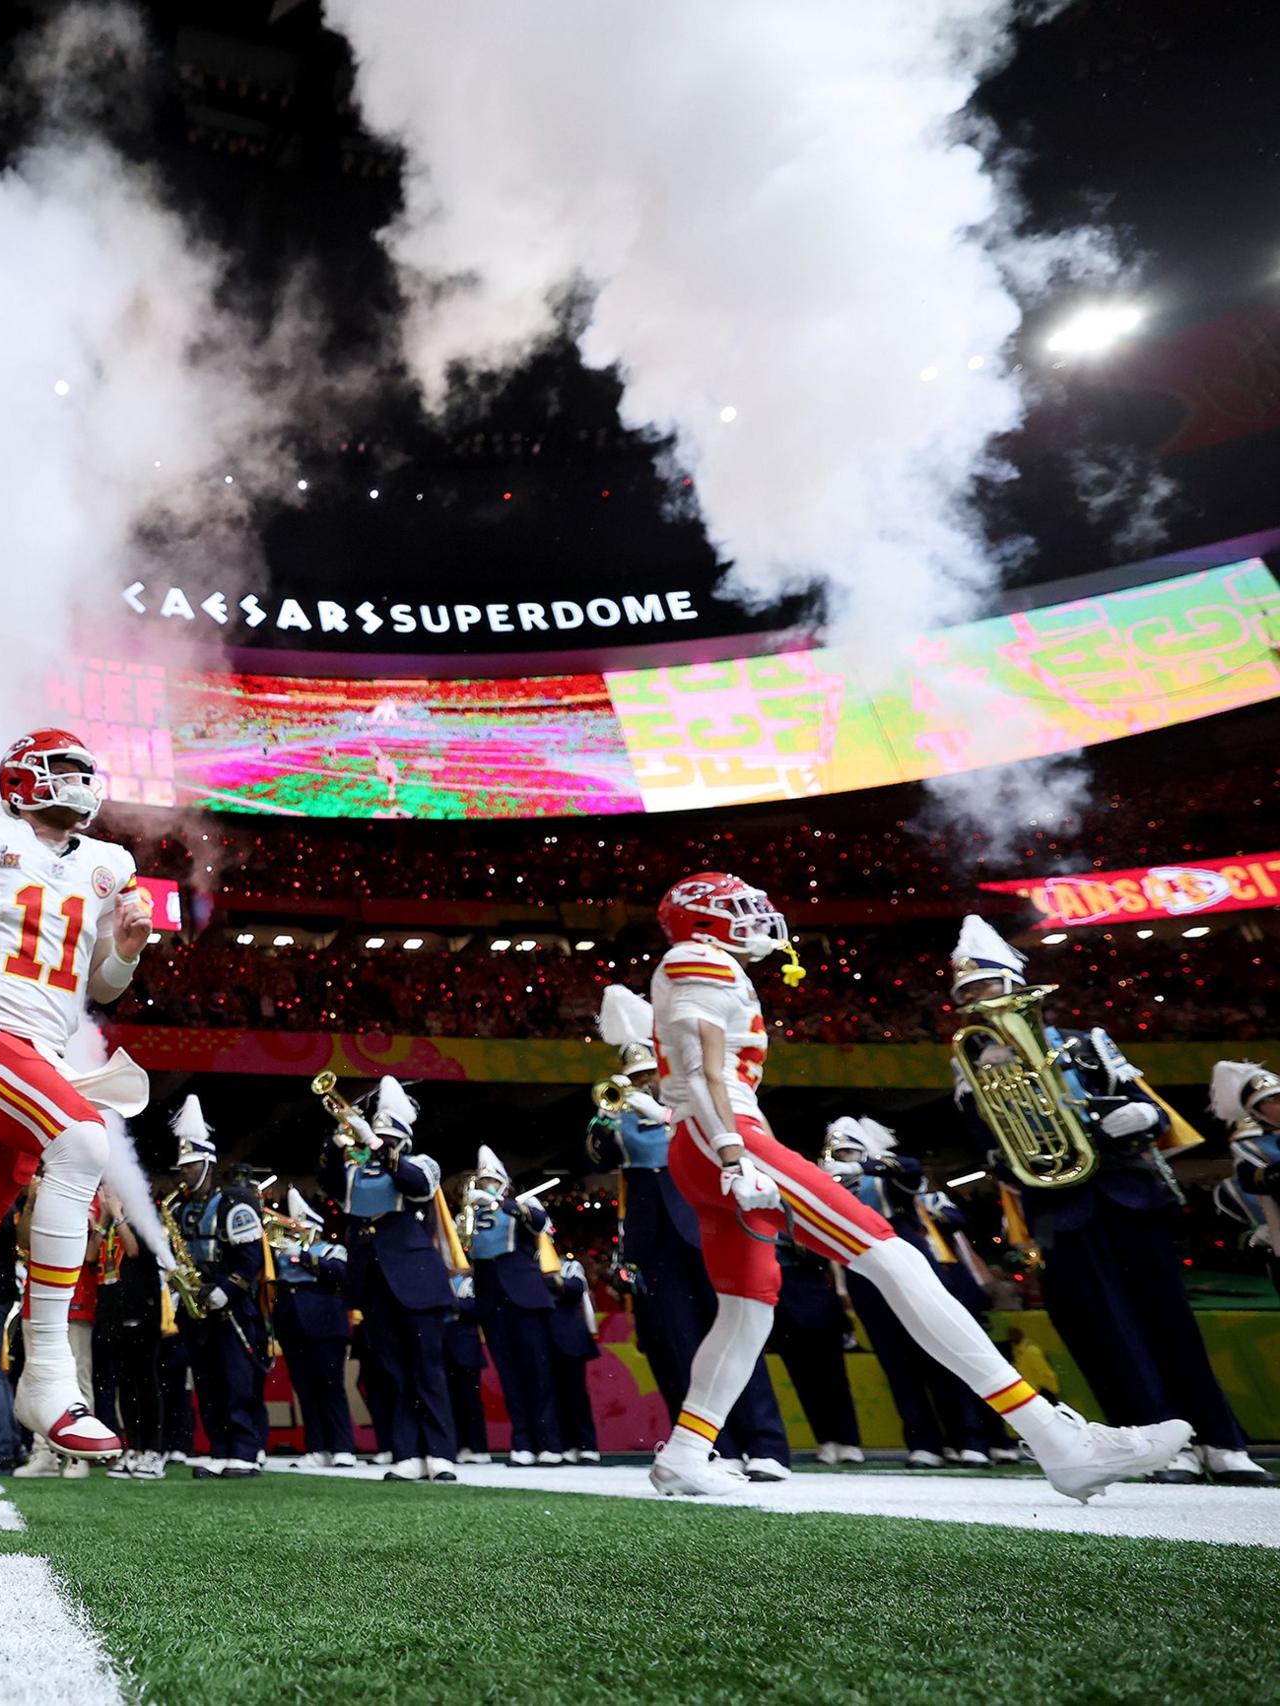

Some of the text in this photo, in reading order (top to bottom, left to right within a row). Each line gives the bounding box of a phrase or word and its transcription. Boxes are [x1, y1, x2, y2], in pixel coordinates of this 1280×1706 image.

[121, 581, 699, 635] CAESARS SUPERDOME
[1225, 860, 1280, 901] CI
[4, 882, 87, 994] 11
